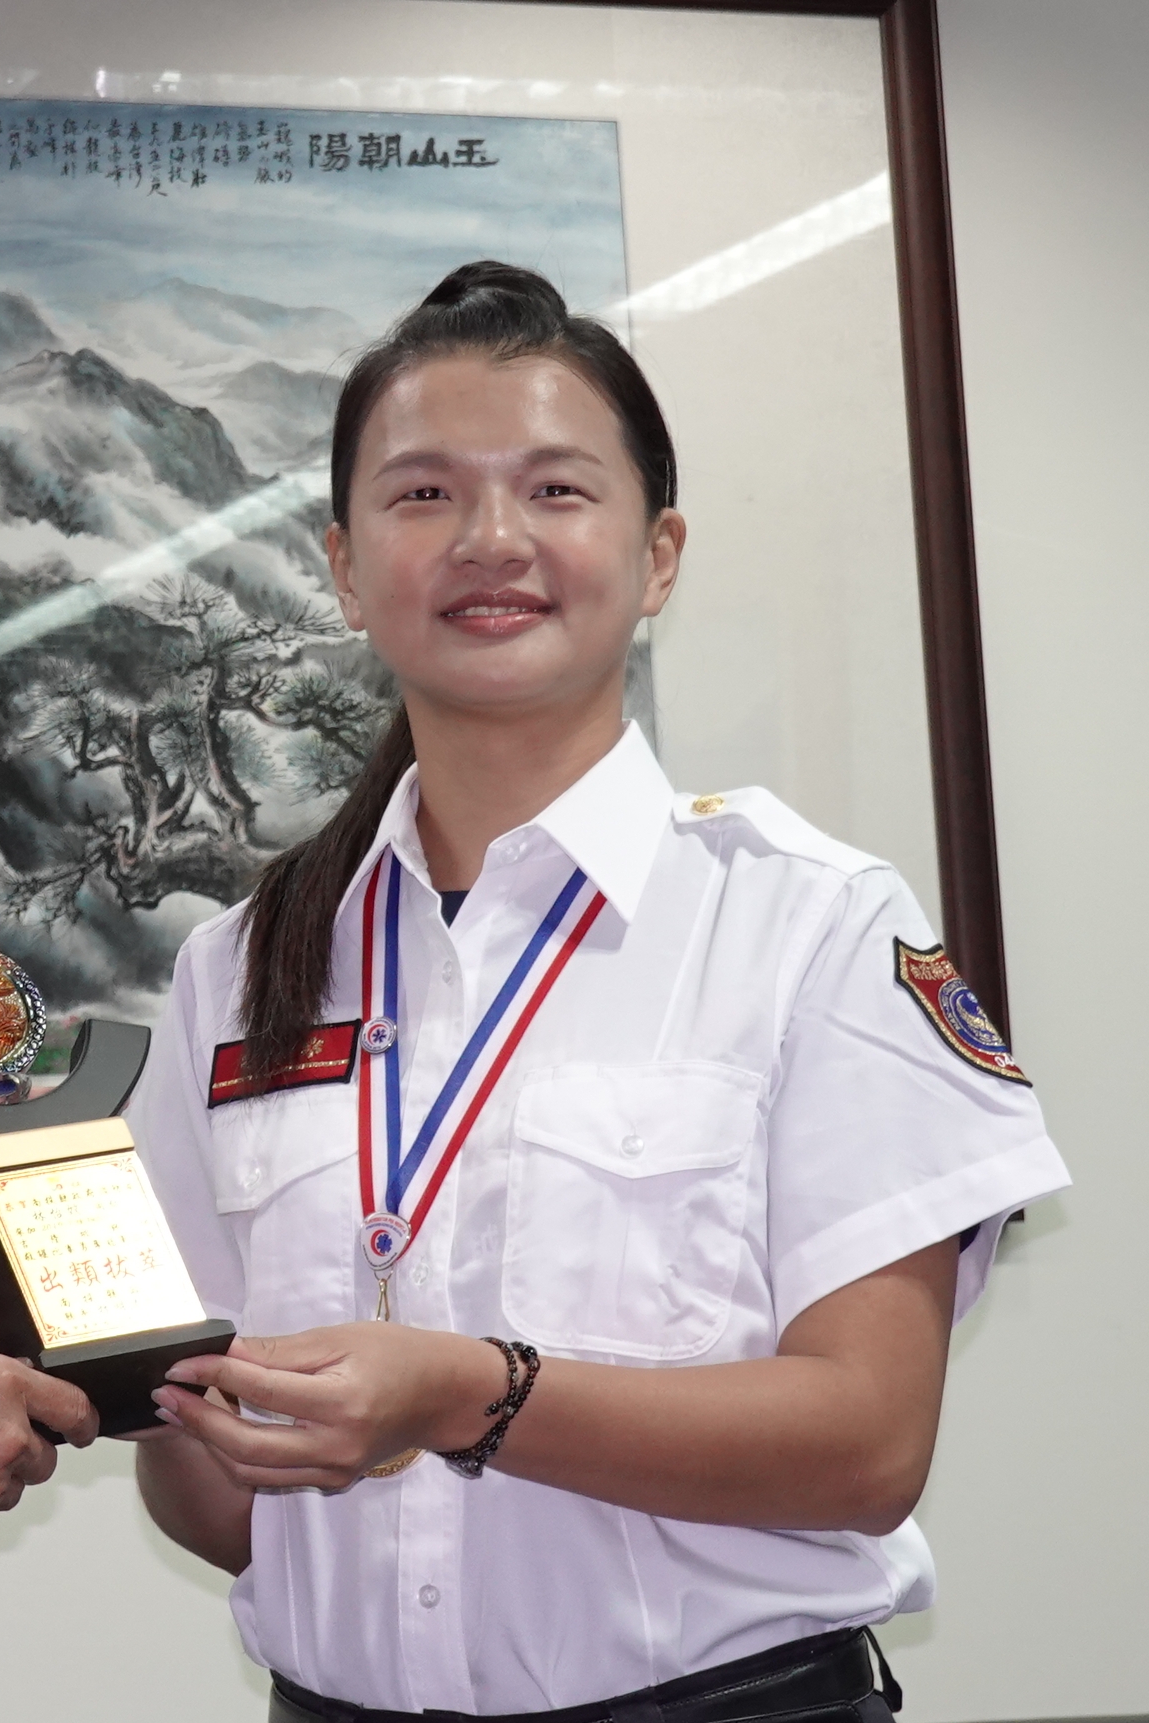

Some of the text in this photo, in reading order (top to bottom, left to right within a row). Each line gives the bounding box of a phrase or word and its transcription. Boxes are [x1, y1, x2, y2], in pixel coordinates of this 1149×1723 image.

[308, 132, 500, 172] 玉山朝陽
[40, 1248, 166, 1293] 出類拔萃
